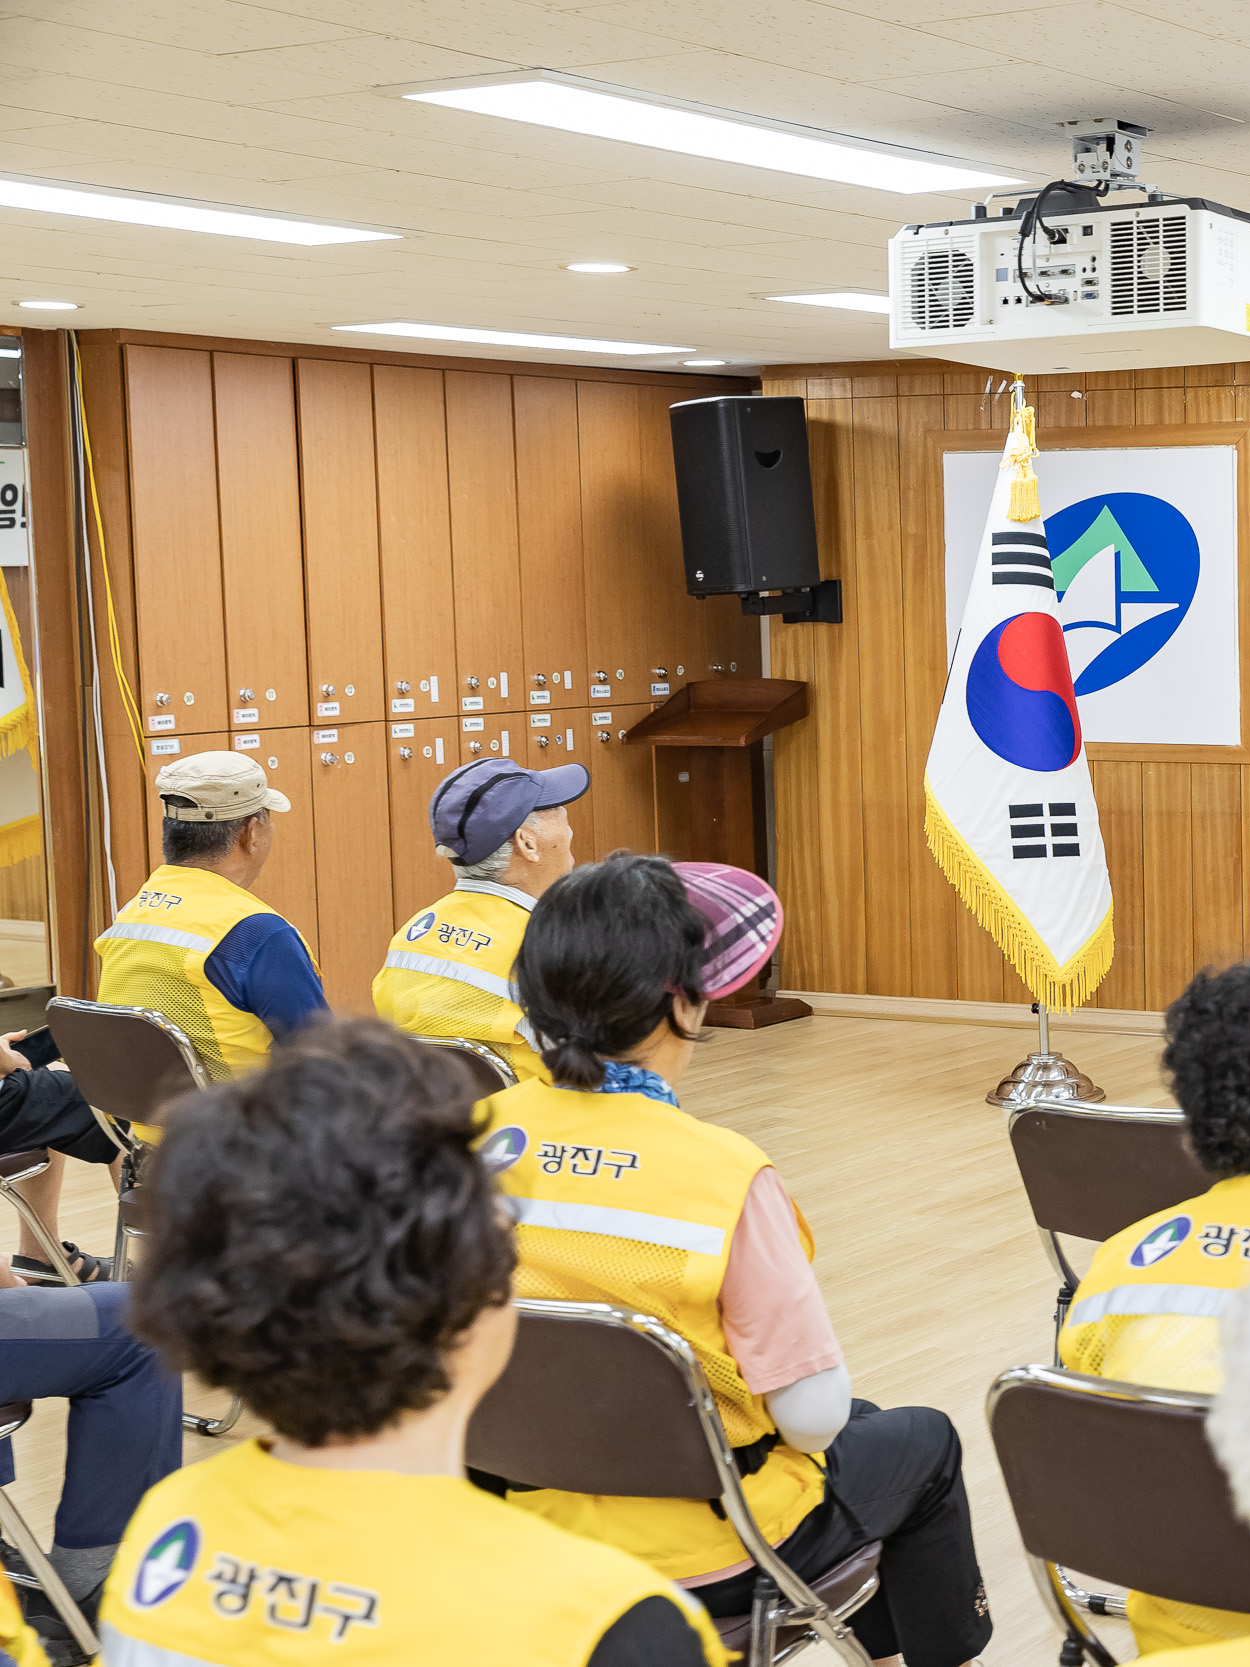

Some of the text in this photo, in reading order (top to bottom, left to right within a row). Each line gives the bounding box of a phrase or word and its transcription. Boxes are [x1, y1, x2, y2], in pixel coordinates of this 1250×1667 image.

[437, 923, 491, 951] 광진구
[536, 1142, 639, 1179] 광진구
[206, 1555, 378, 1638] 광진구
